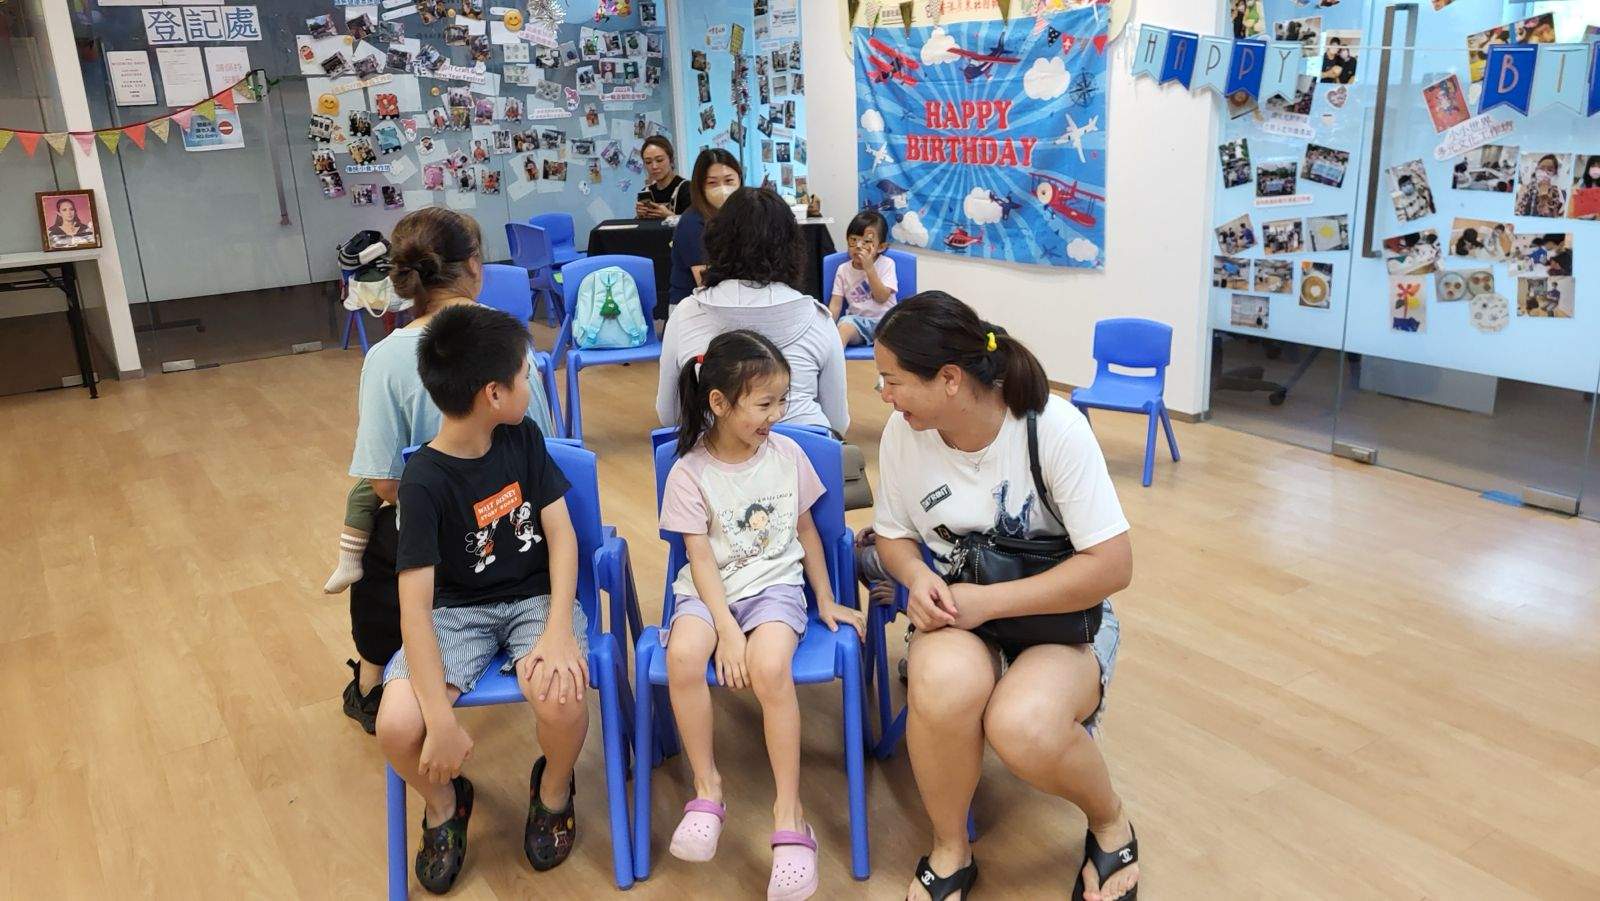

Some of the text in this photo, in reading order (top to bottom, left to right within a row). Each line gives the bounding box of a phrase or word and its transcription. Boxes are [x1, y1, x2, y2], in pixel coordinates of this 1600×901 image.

[146, 7, 260, 43] 登記處
[1144, 32, 1292, 83] HAPPY
[924, 99, 1013, 130] HAPPY
[905, 134, 1037, 167] BIRTHDAY
[478, 489, 516, 514] WALT DISNEY
